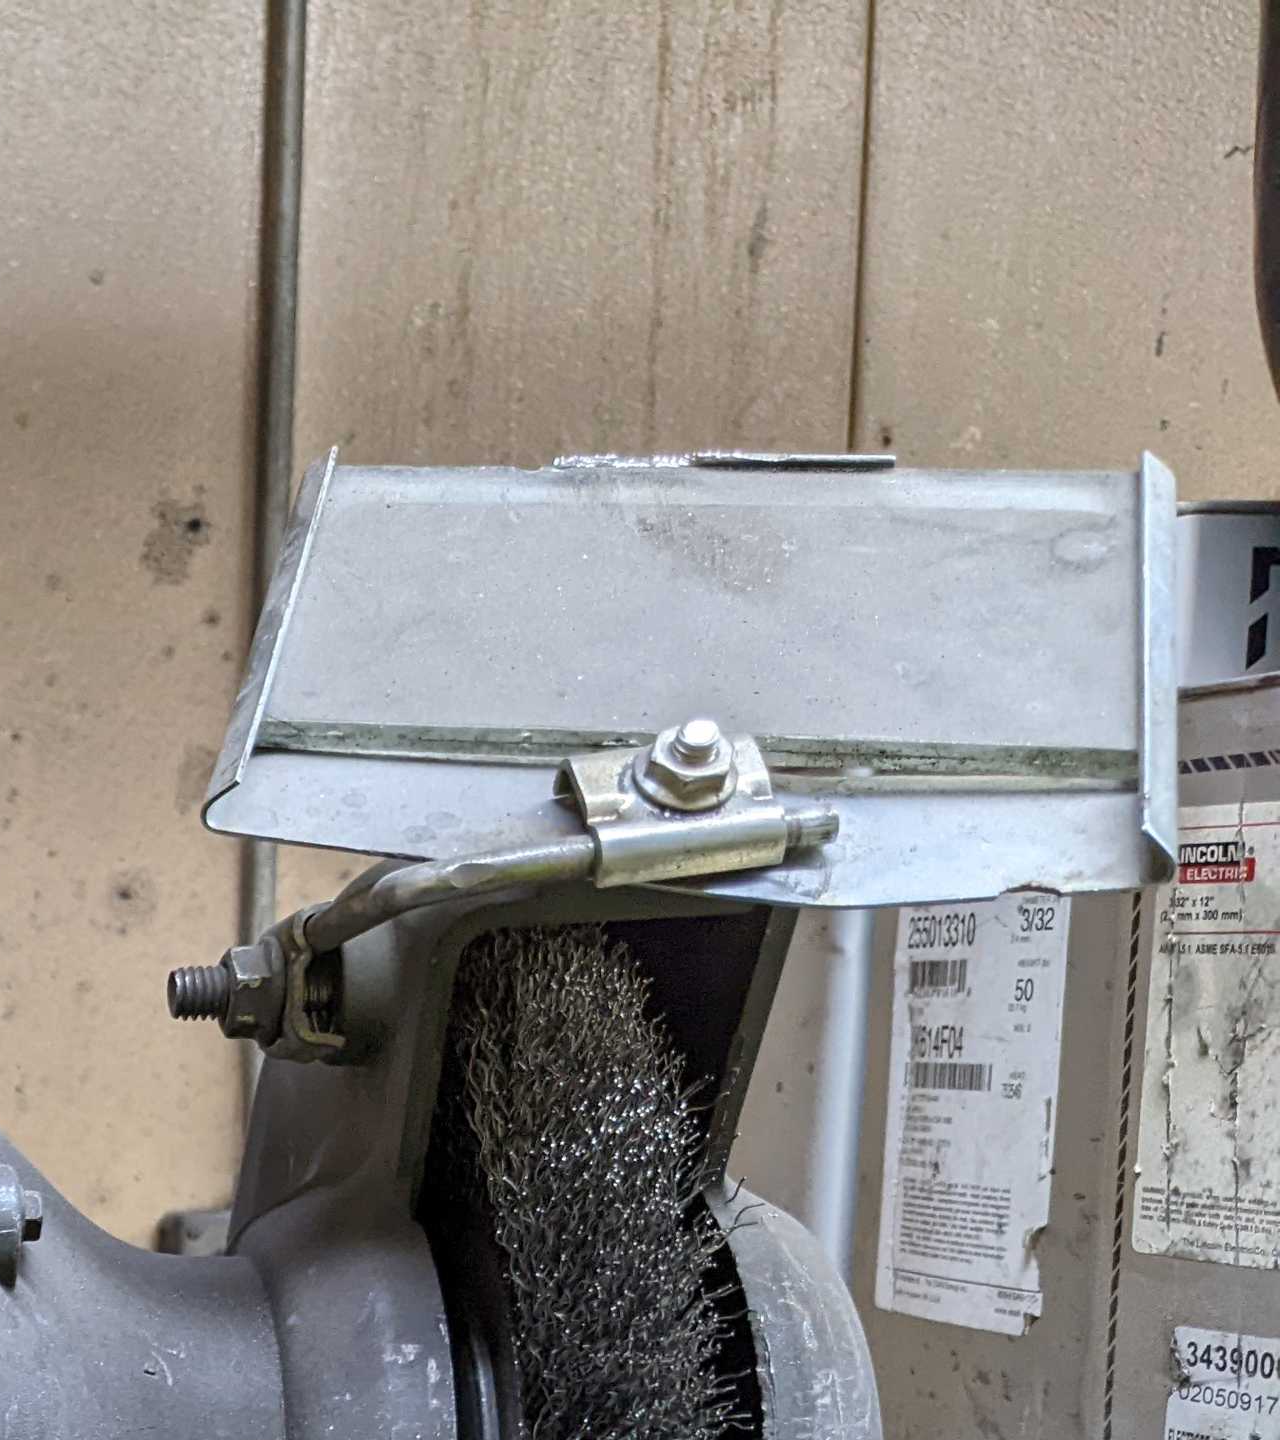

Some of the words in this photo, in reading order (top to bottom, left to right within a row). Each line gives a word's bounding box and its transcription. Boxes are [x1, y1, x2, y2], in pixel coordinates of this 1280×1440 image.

[1180, 844, 1240, 864] INCOLN
[1020, 907, 1055, 931] 3/32
[1014, 978, 1034, 1001] 50
[1186, 1341, 1280, 1380] 343900
